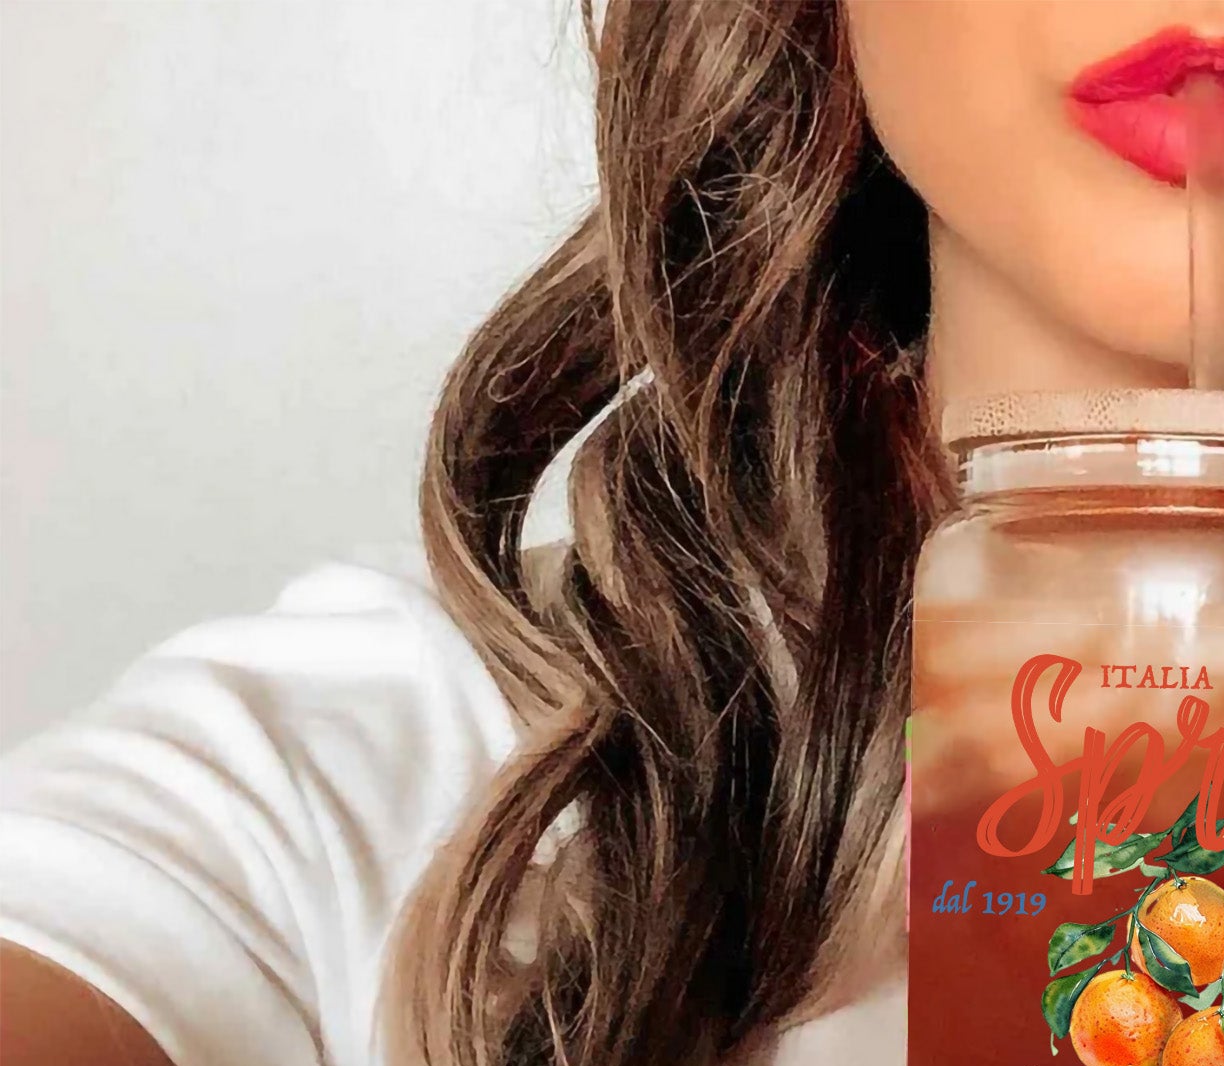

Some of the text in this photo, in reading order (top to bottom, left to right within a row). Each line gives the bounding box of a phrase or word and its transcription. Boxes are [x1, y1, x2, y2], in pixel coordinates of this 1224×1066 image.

[1100, 664, 1214, 691] ITALIA
[932, 879, 1048, 917] dal 1919
